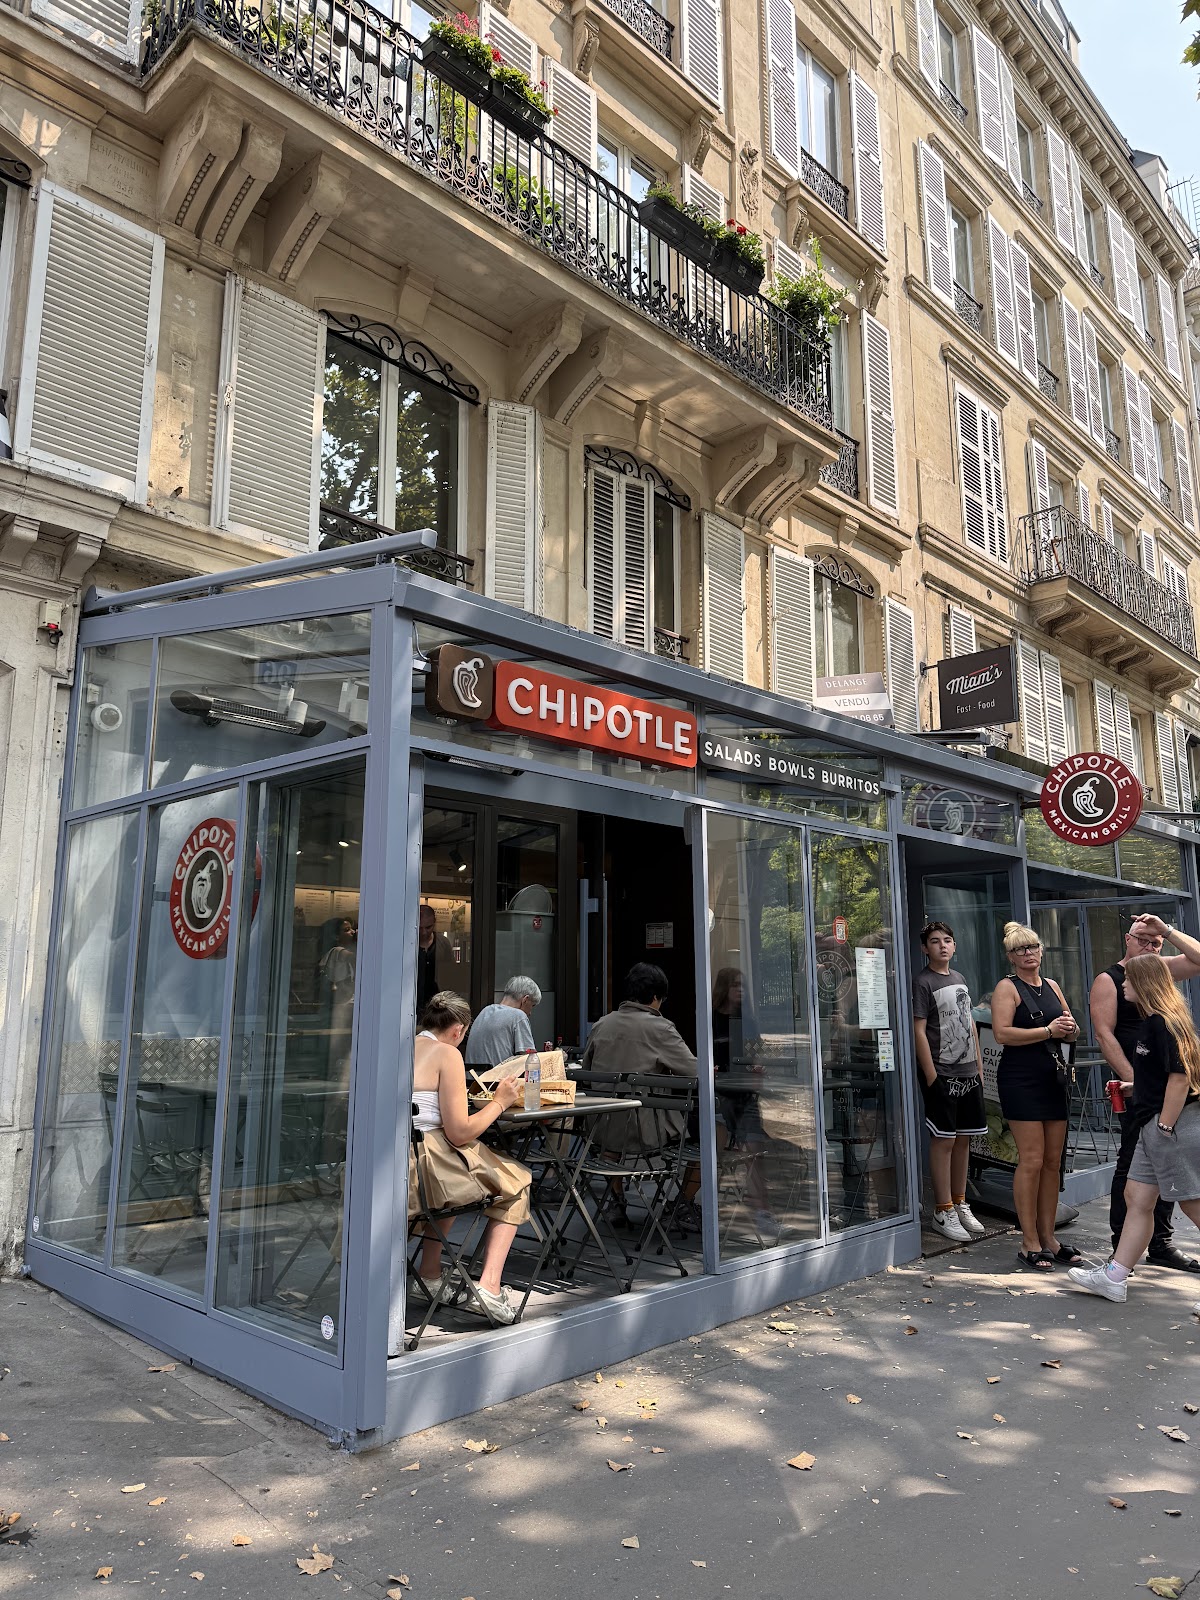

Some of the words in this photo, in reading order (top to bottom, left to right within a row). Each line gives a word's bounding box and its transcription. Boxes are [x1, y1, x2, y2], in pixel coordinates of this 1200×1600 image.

[825, 678, 868, 689] DELANGE
[946, 665, 1003, 695] Miam's
[507, 677, 692, 755] CHIPOTLE
[834, 697, 870, 707] VENDU
[956, 704, 972, 714] Fast
[978, 698, 996, 710] Food
[704, 741, 762, 768] SALADS
[768, 757, 816, 780] BOWLS
[822, 770, 880, 795] BURRITOS
[1046, 755, 1132, 793] CHIPOTLE
[1049, 809, 1099, 840] MEXICAN
[1102, 805, 1131, 836] GRILL
[172, 905, 207, 952] MEXICAN
